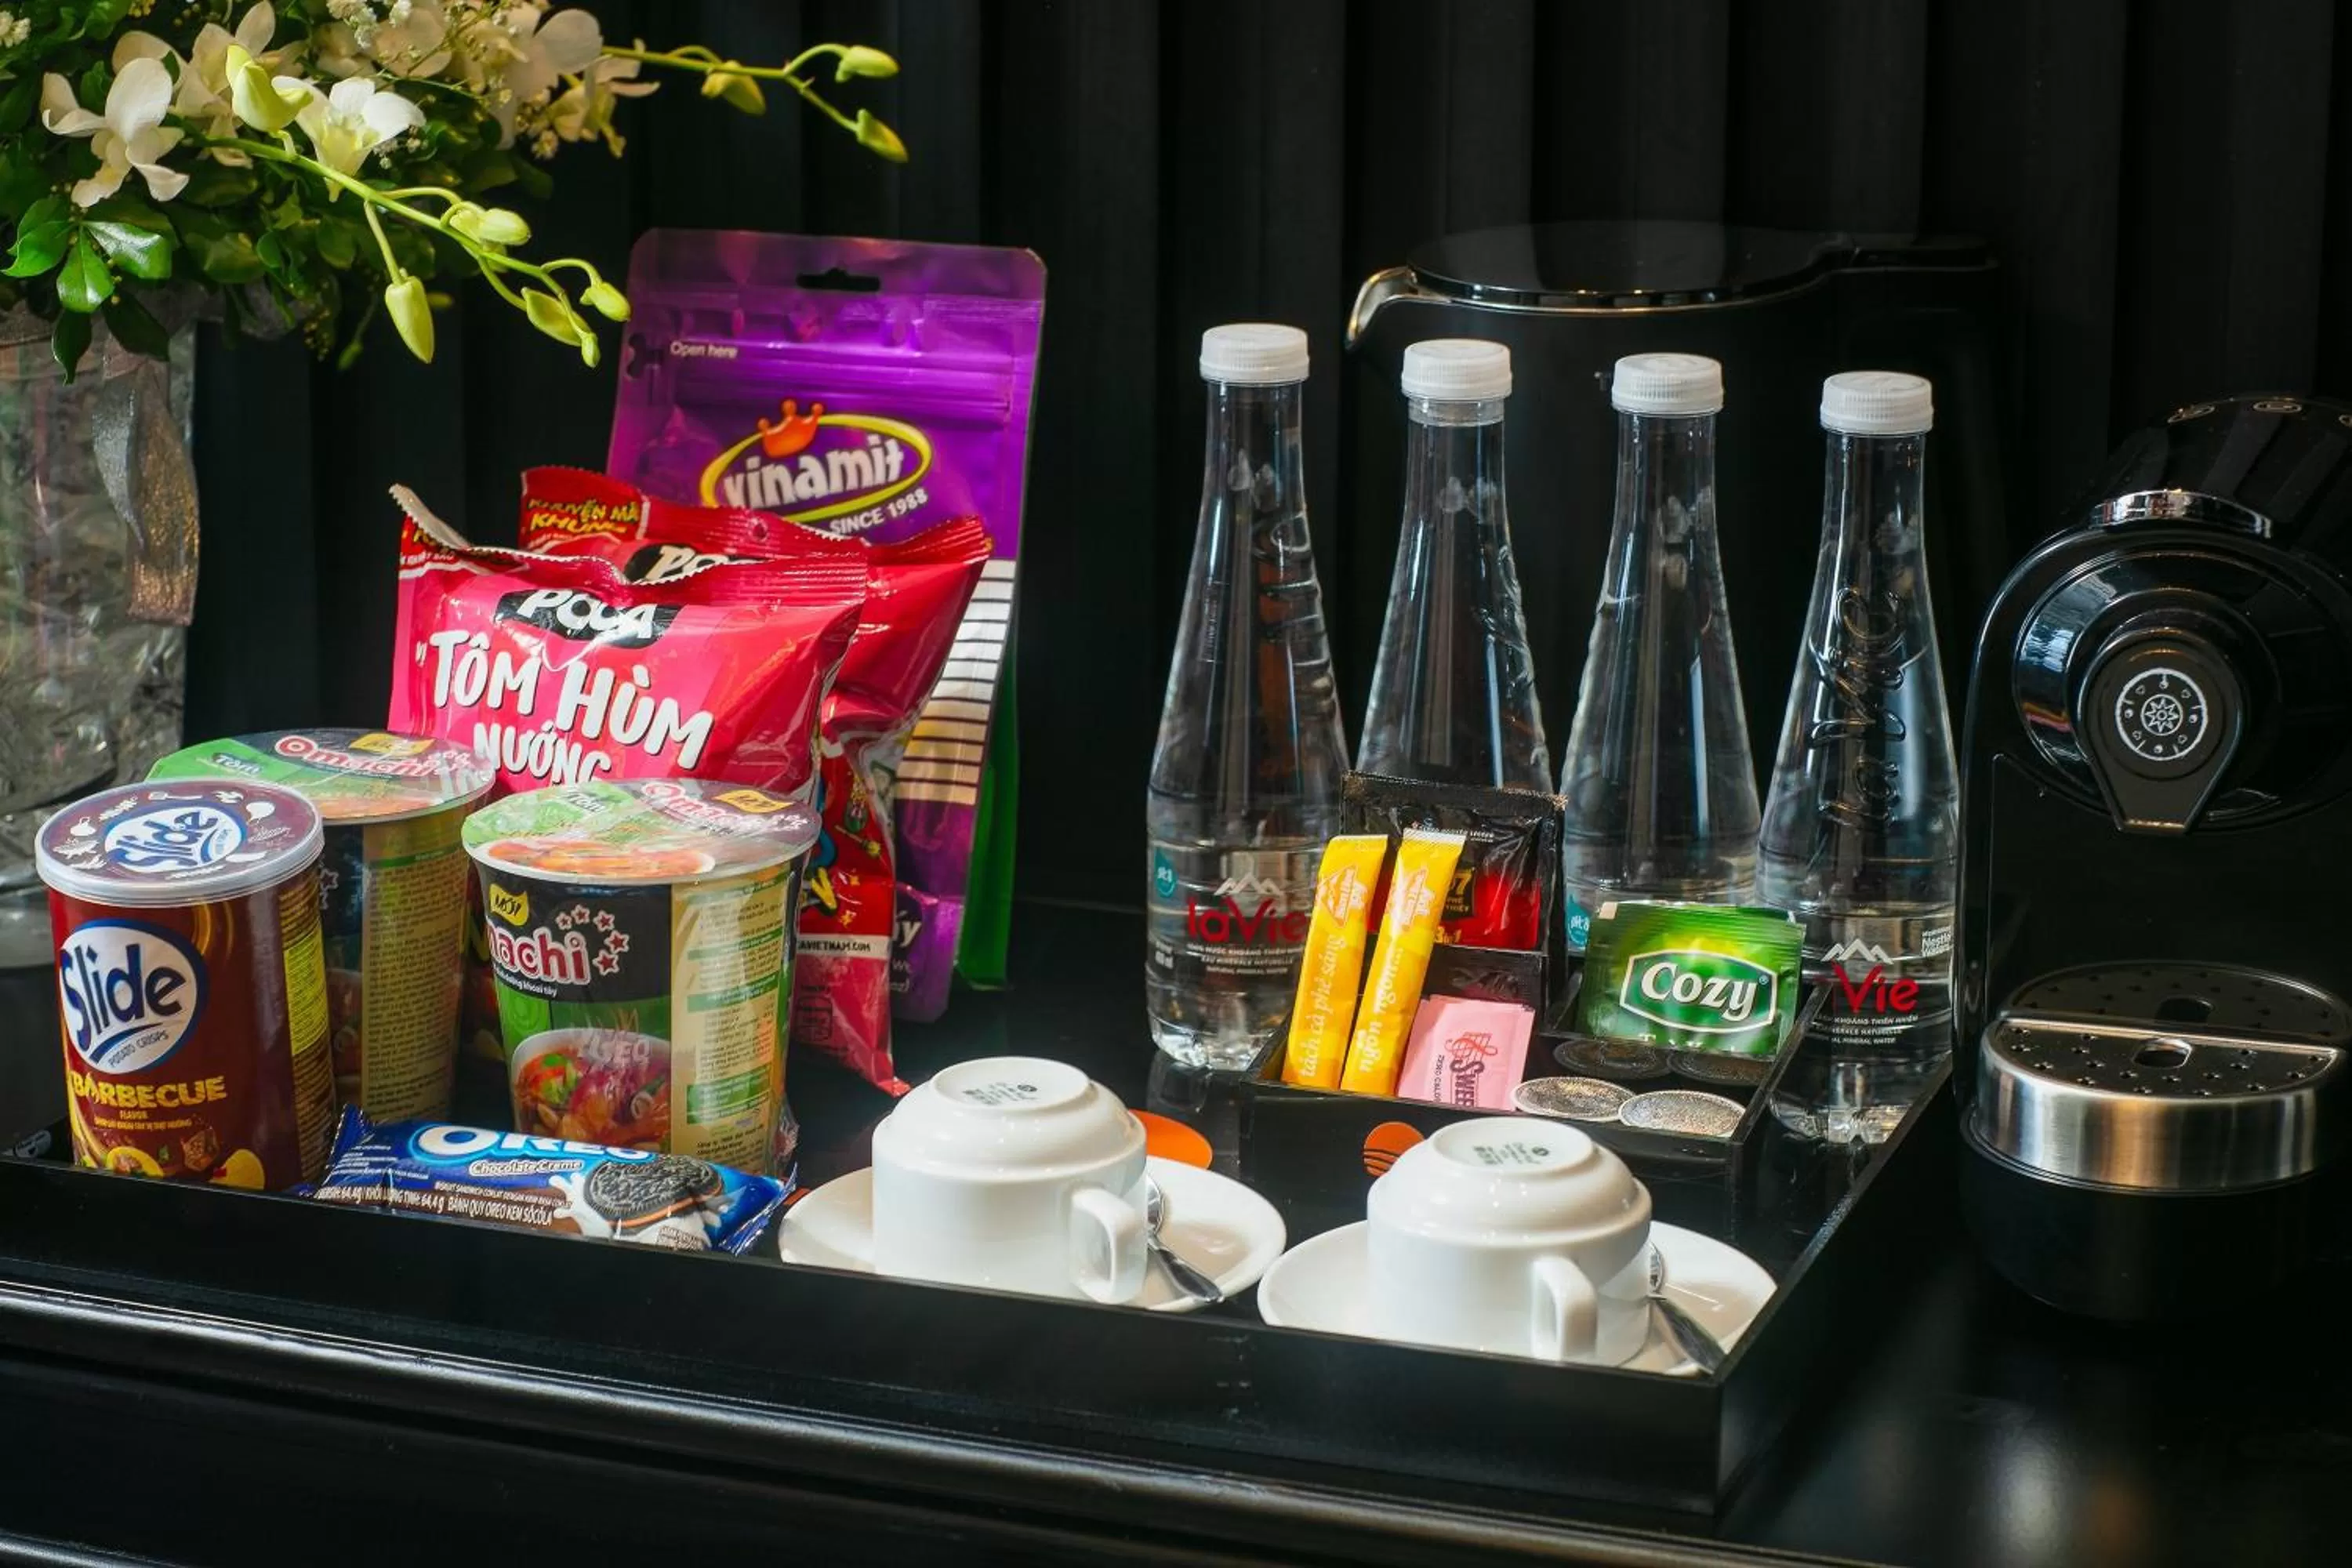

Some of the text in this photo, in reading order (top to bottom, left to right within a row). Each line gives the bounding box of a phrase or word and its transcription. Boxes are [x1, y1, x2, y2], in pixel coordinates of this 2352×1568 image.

[670, 340, 738, 358] Open here
[723, 434, 905, 509] vinamit
[829, 488, 929, 536] SINCE 1988
[429, 630, 542, 716] TÔM
[555, 660, 715, 770] HÙM
[485, 919, 590, 985] achi
[798, 939, 871, 953] AVIETNAM.COM
[60, 943, 187, 1053] Slide
[1641, 962, 1758, 1022] Cozy
[1830, 960, 1920, 1015] Vie
[71, 1073, 228, 1109] BARBECUE
[1432, 1076, 1442, 1102] CALO
[1449, 1058, 1485, 1107] SWEE
[472, 1160, 581, 1175] Chocolate Creme
